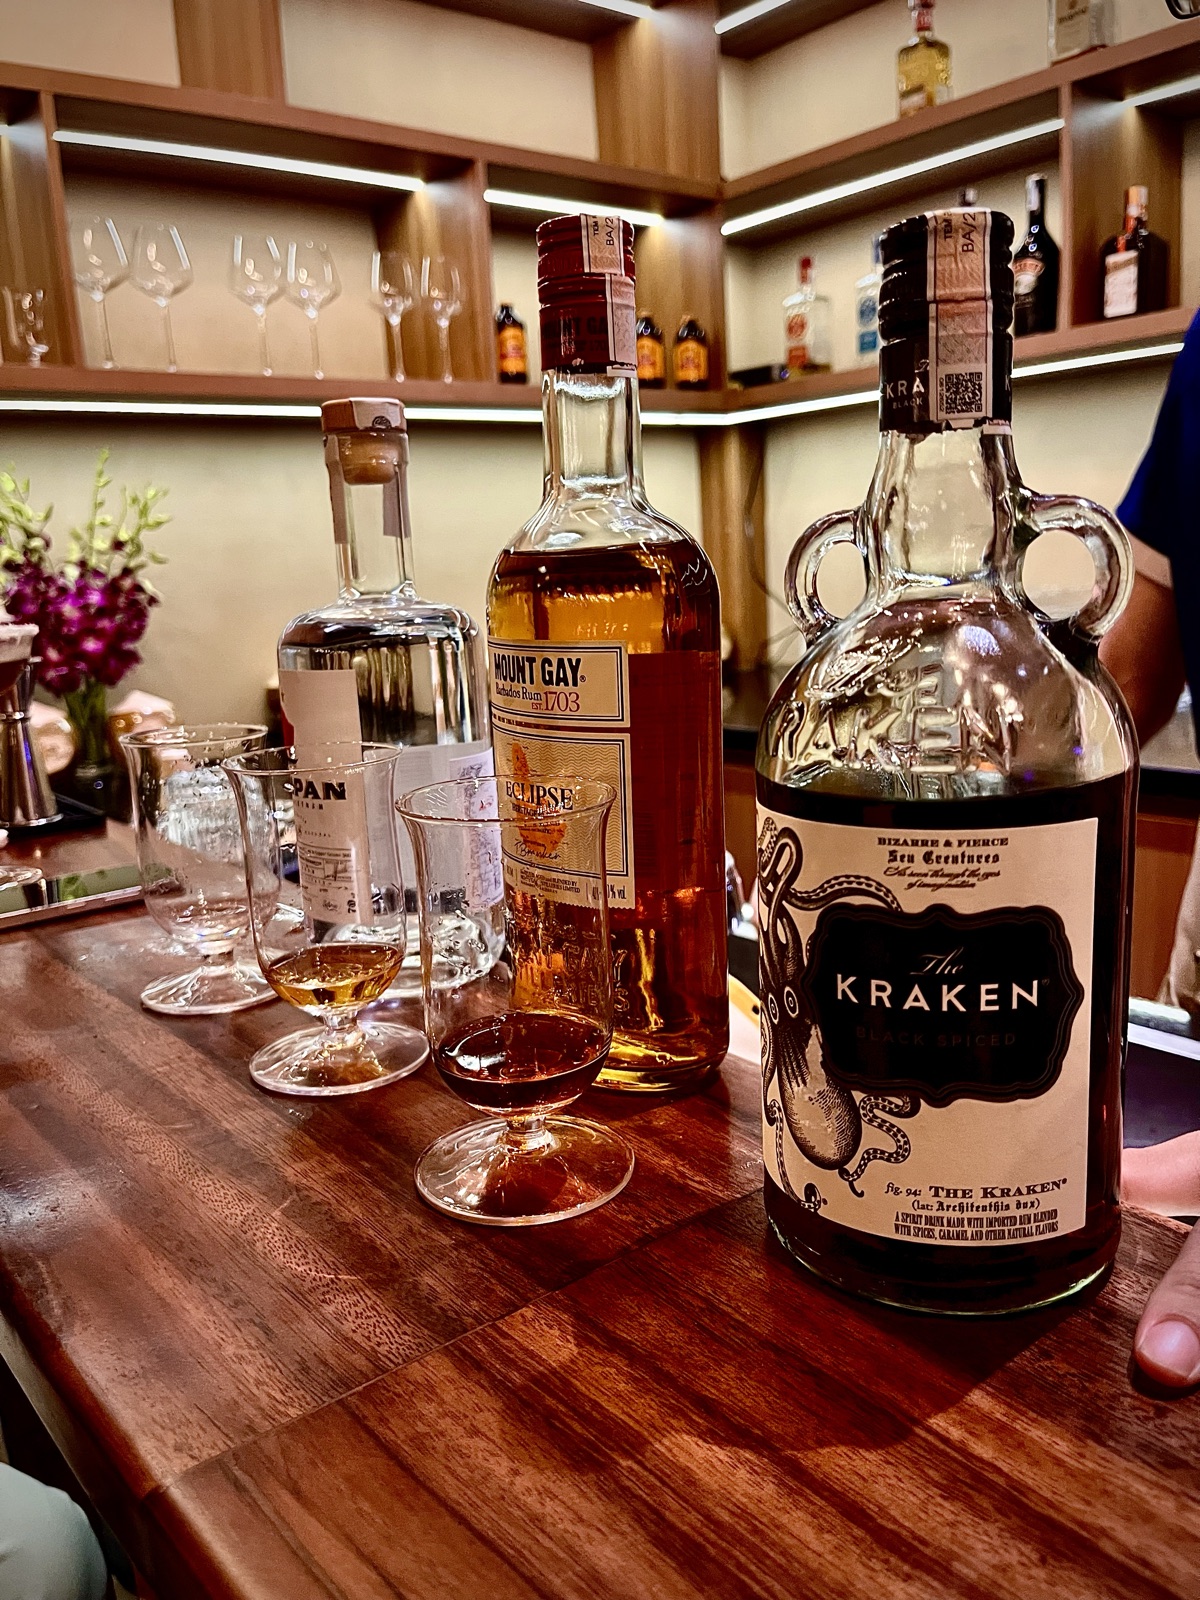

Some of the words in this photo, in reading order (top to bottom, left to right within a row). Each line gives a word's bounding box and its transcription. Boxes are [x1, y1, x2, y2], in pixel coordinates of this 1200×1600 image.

[494, 652, 536, 685] MOUNT
[541, 657, 582, 687] GAY
[495, 682, 521, 699] Barbados
[521, 686, 543, 701] Rum
[543, 691, 580, 712] 1703
[506, 781, 573, 811] ECLIPSE
[877, 837, 939, 848] BIZARRE
[957, 837, 1009, 848] FIERCE
[887, 849, 915, 864] Sea
[922, 850, 1000, 865] Creatures
[909, 946, 964, 975] The
[836, 973, 1039, 1013] KRAKEN
[855, 1025, 925, 1046] BLACK
[935, 1032, 1017, 1048] SPICED
[884, 1182, 902, 1196] fig.
[905, 1188, 922, 1197] 94:
[929, 1185, 973, 1199] THE
[980, 1179, 1064, 1199] KRAKEN
[894, 1211, 900, 1222] A
[901, 1212, 923, 1225] SPIRIT
[924, 1215, 945, 1228] DRINK
[946, 1217, 966, 1228] MADE
[966, 1217, 984, 1229] WITH
[985, 1216, 1017, 1228] IMPORTED
[1018, 1213, 1032, 1226] RUM
[1033, 1209, 1058, 1223] BLENDED
[894, 1223, 911, 1236] WITH
[912, 1226, 938, 1240] SPICES,
[938, 1229, 969, 1241] CARAMEL
[970, 1230, 984, 1241] AND
[984, 1229, 1007, 1241] OTHER
[1007, 1226, 1034, 1240] NATURAL
[1034, 1221, 1059, 1236] FLAVORS
